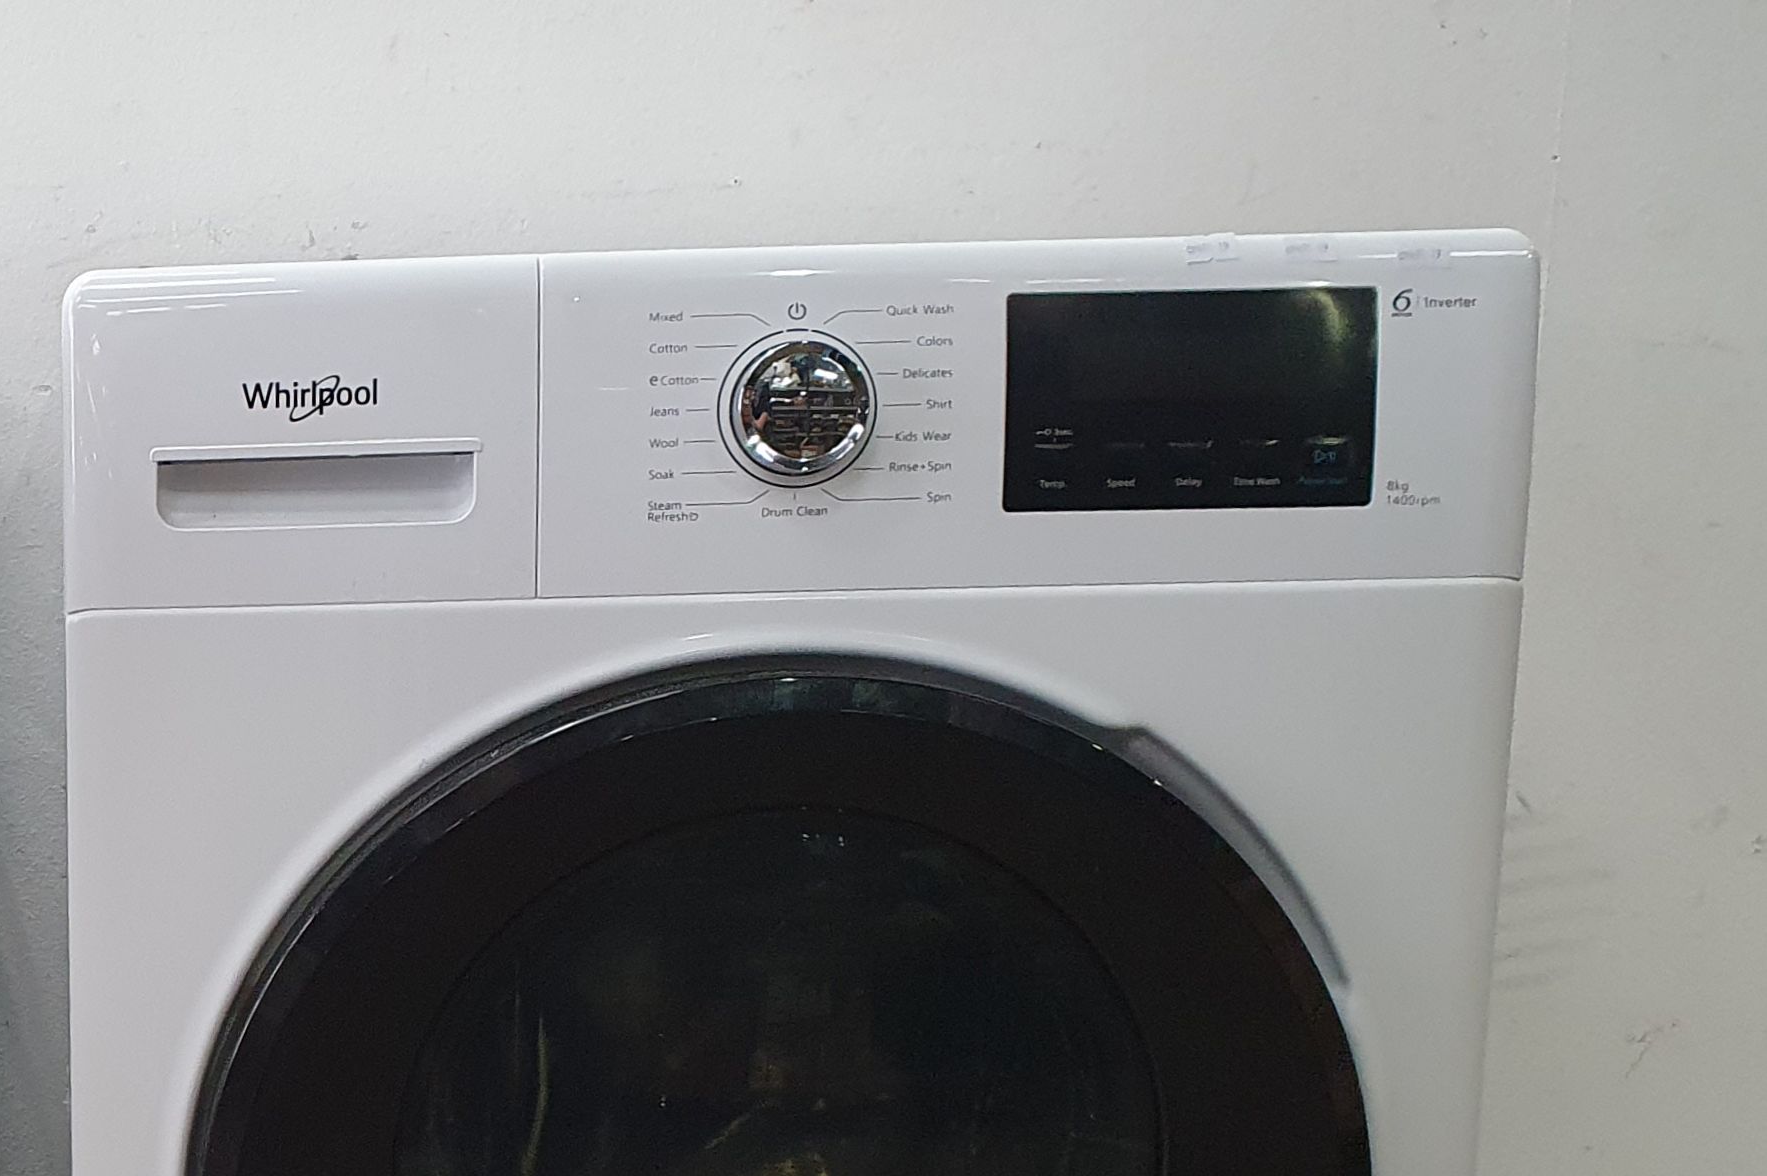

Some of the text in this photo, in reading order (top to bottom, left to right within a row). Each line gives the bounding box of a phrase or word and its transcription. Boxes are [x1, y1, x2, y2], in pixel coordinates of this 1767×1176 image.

[1423, 296, 1477, 308] Inverter
[886, 304, 954, 316] Quick Wash
[649, 312, 683, 322] Mixed
[917, 336, 953, 347] Colors
[649, 343, 688, 354] Cotton
[902, 368, 953, 379] Delicates
[242, 376, 378, 421] Whirlpool
[926, 399, 953, 410] Shirt
[650, 407, 680, 417] Jeans
[895, 431, 952, 442] Kids Wear
[649, 438, 679, 448] Wool
[648, 469, 675, 480] Soak
[926, 492, 952, 503] Spin
[648, 501, 682, 511] Steam
[761, 506, 829, 517] Drum Clean
